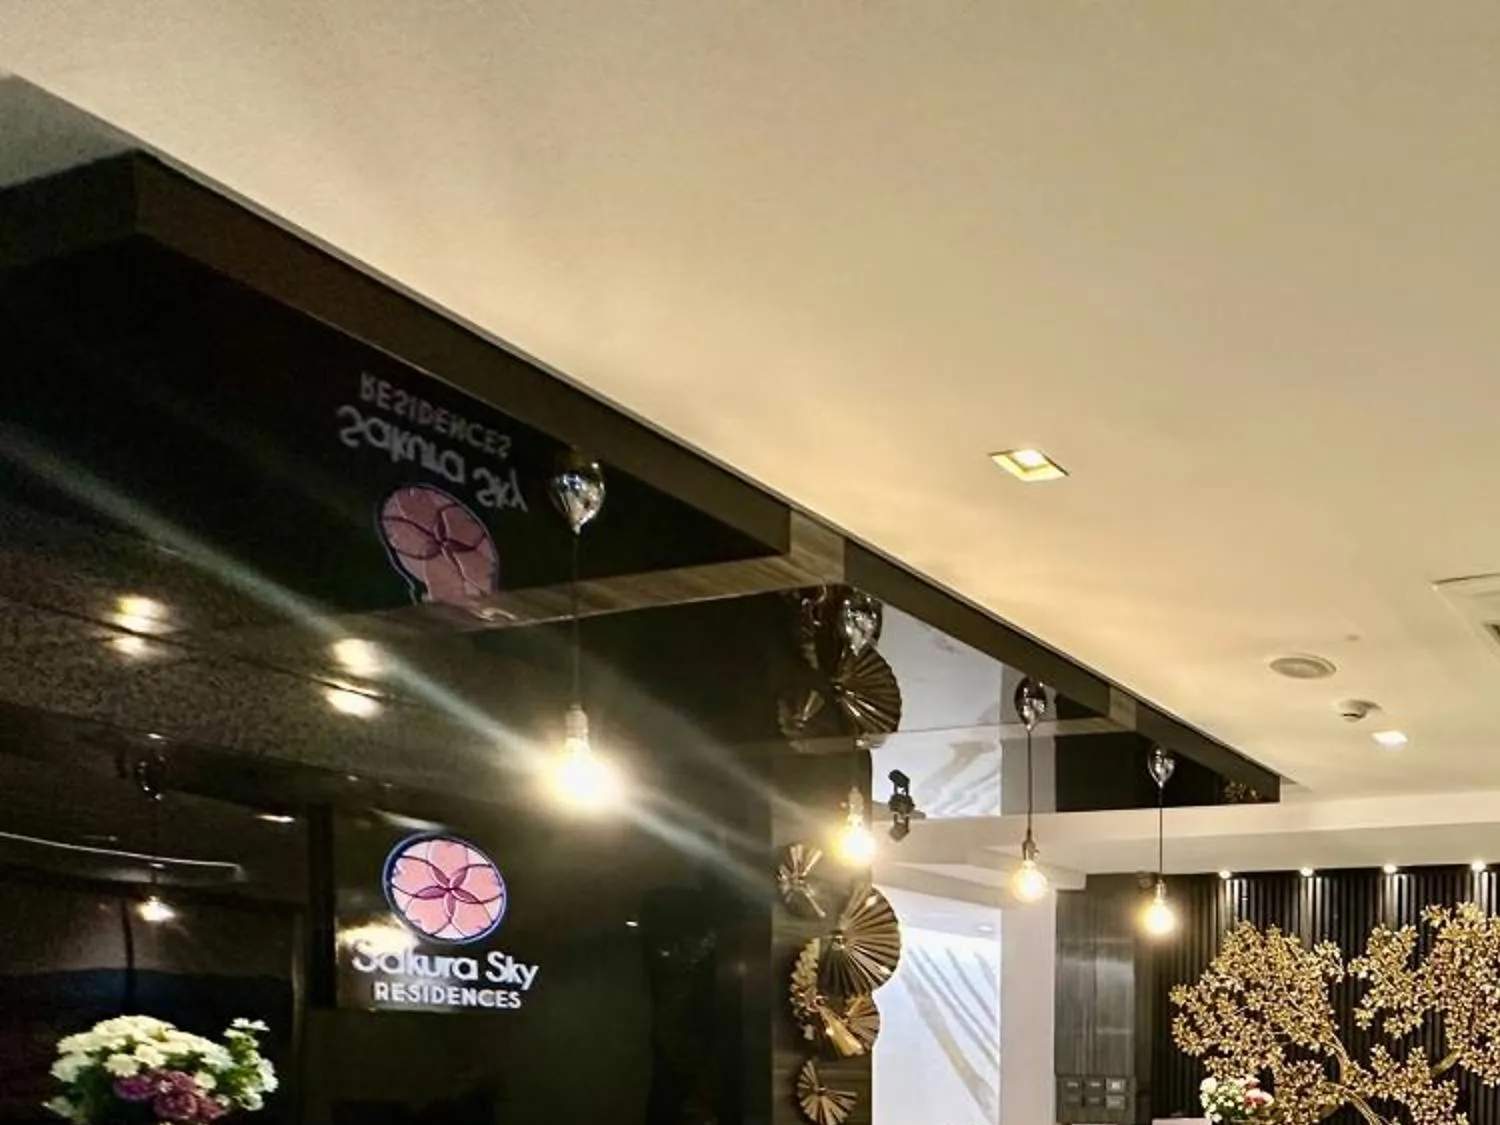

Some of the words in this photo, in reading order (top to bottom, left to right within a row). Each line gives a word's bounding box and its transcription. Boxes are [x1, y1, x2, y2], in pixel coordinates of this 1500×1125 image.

[351, 940, 479, 981] Sakura
[485, 951, 540, 991] Sky
[373, 981, 522, 1009] RESIDENCES
